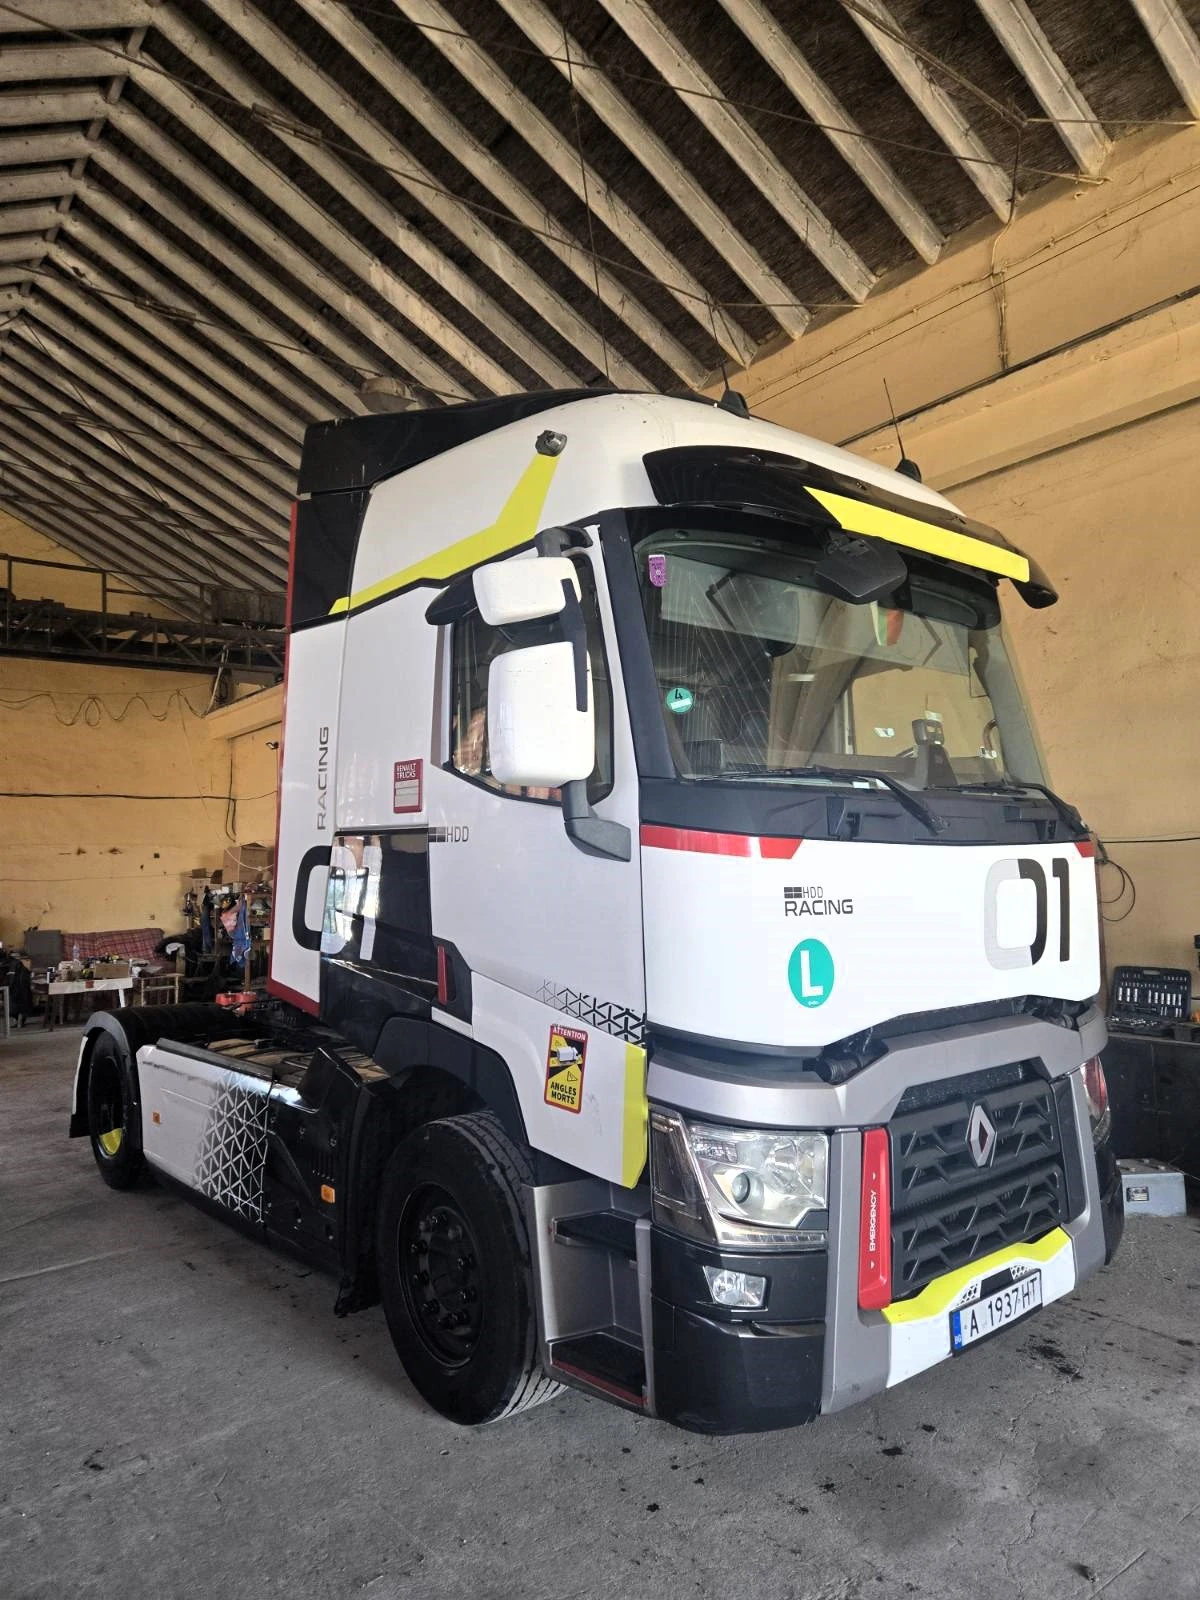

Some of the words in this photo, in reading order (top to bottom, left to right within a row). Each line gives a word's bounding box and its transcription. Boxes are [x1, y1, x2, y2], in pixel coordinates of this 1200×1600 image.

[675, 688, 683, 700] 4
[396, 763, 417, 772] RENAULT
[396, 771, 416, 779] TRUCKS
[317, 726, 329, 830] RACING
[446, 825, 470, 842] HDD
[802, 886, 824, 899] HDD
[292, 845, 382, 960] 01
[784, 898, 854, 917] RACING
[984, 857, 1070, 970] 01
[800, 949, 824, 998] L
[552, 1026, 586, 1041] ATTENTION
[550, 1081, 577, 1096] ANGLES
[551, 1090, 575, 1105] MORTS
[869, 1189, 877, 1252] EMERGENCY
[970, 1309, 979, 1337] A
[987, 1287, 1019, 1327] 1937
[1021, 1276, 1038, 1309] HT
